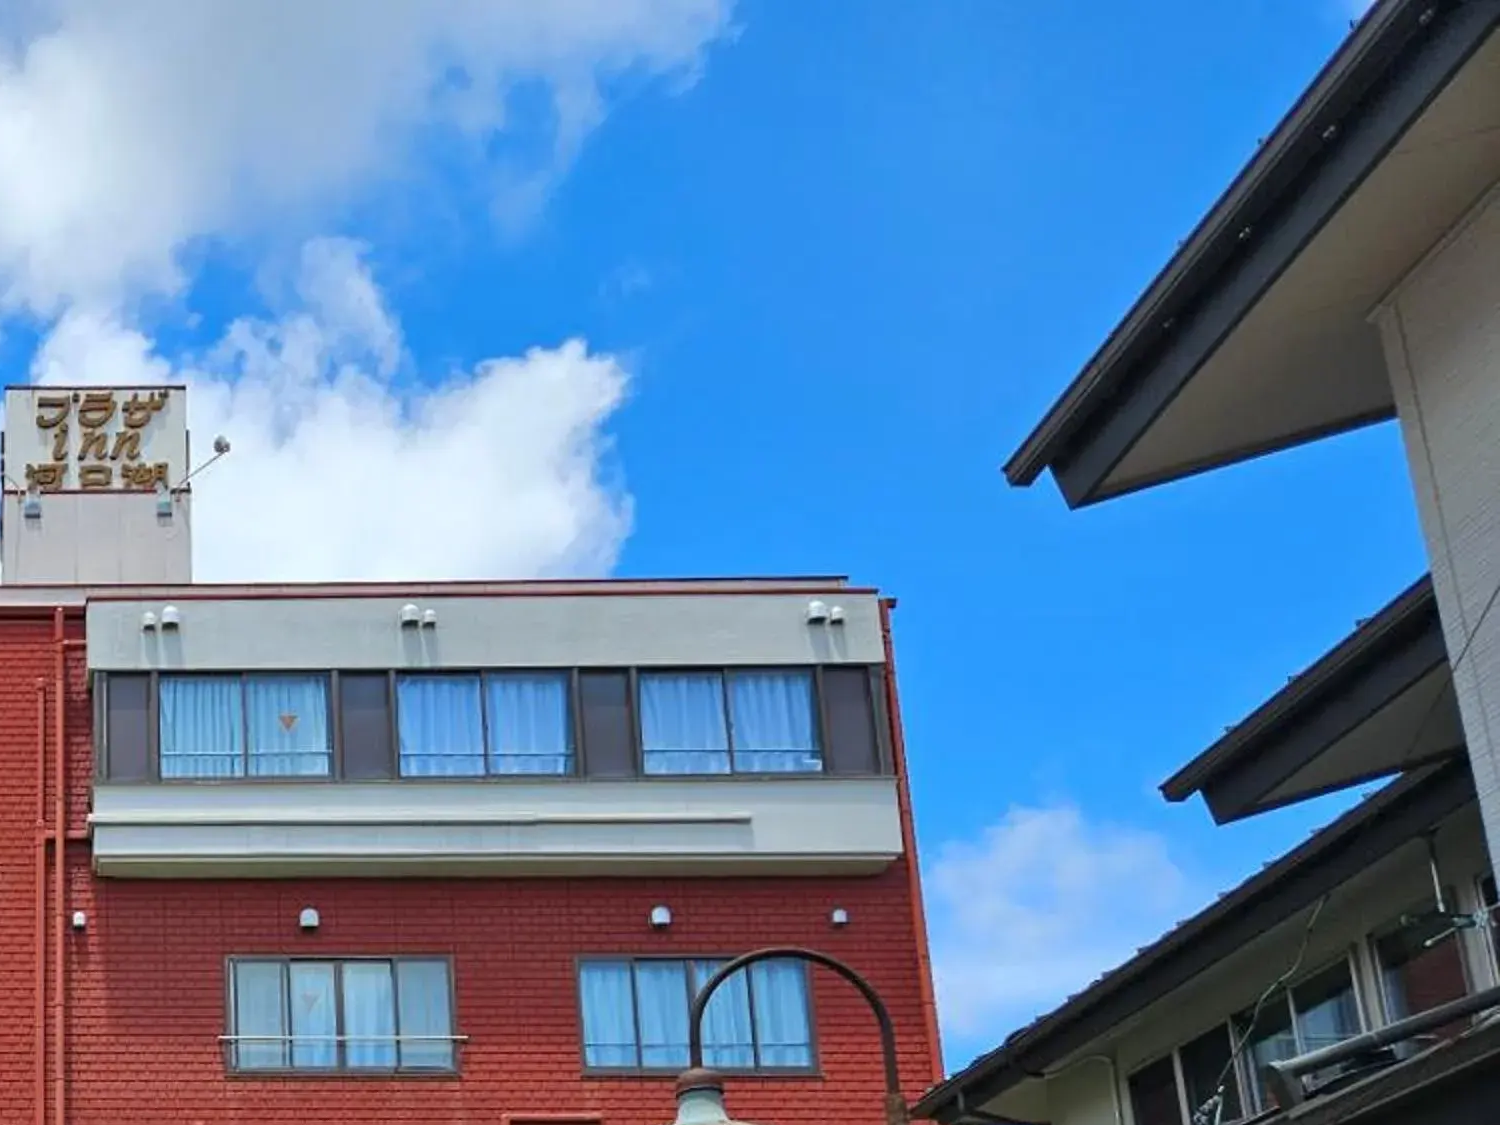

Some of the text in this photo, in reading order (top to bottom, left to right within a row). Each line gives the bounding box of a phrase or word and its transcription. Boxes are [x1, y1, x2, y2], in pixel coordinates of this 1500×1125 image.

[36, 389, 170, 429] プラザ
[52, 424, 141, 461] inn
[26, 463, 169, 490] 河口湖
